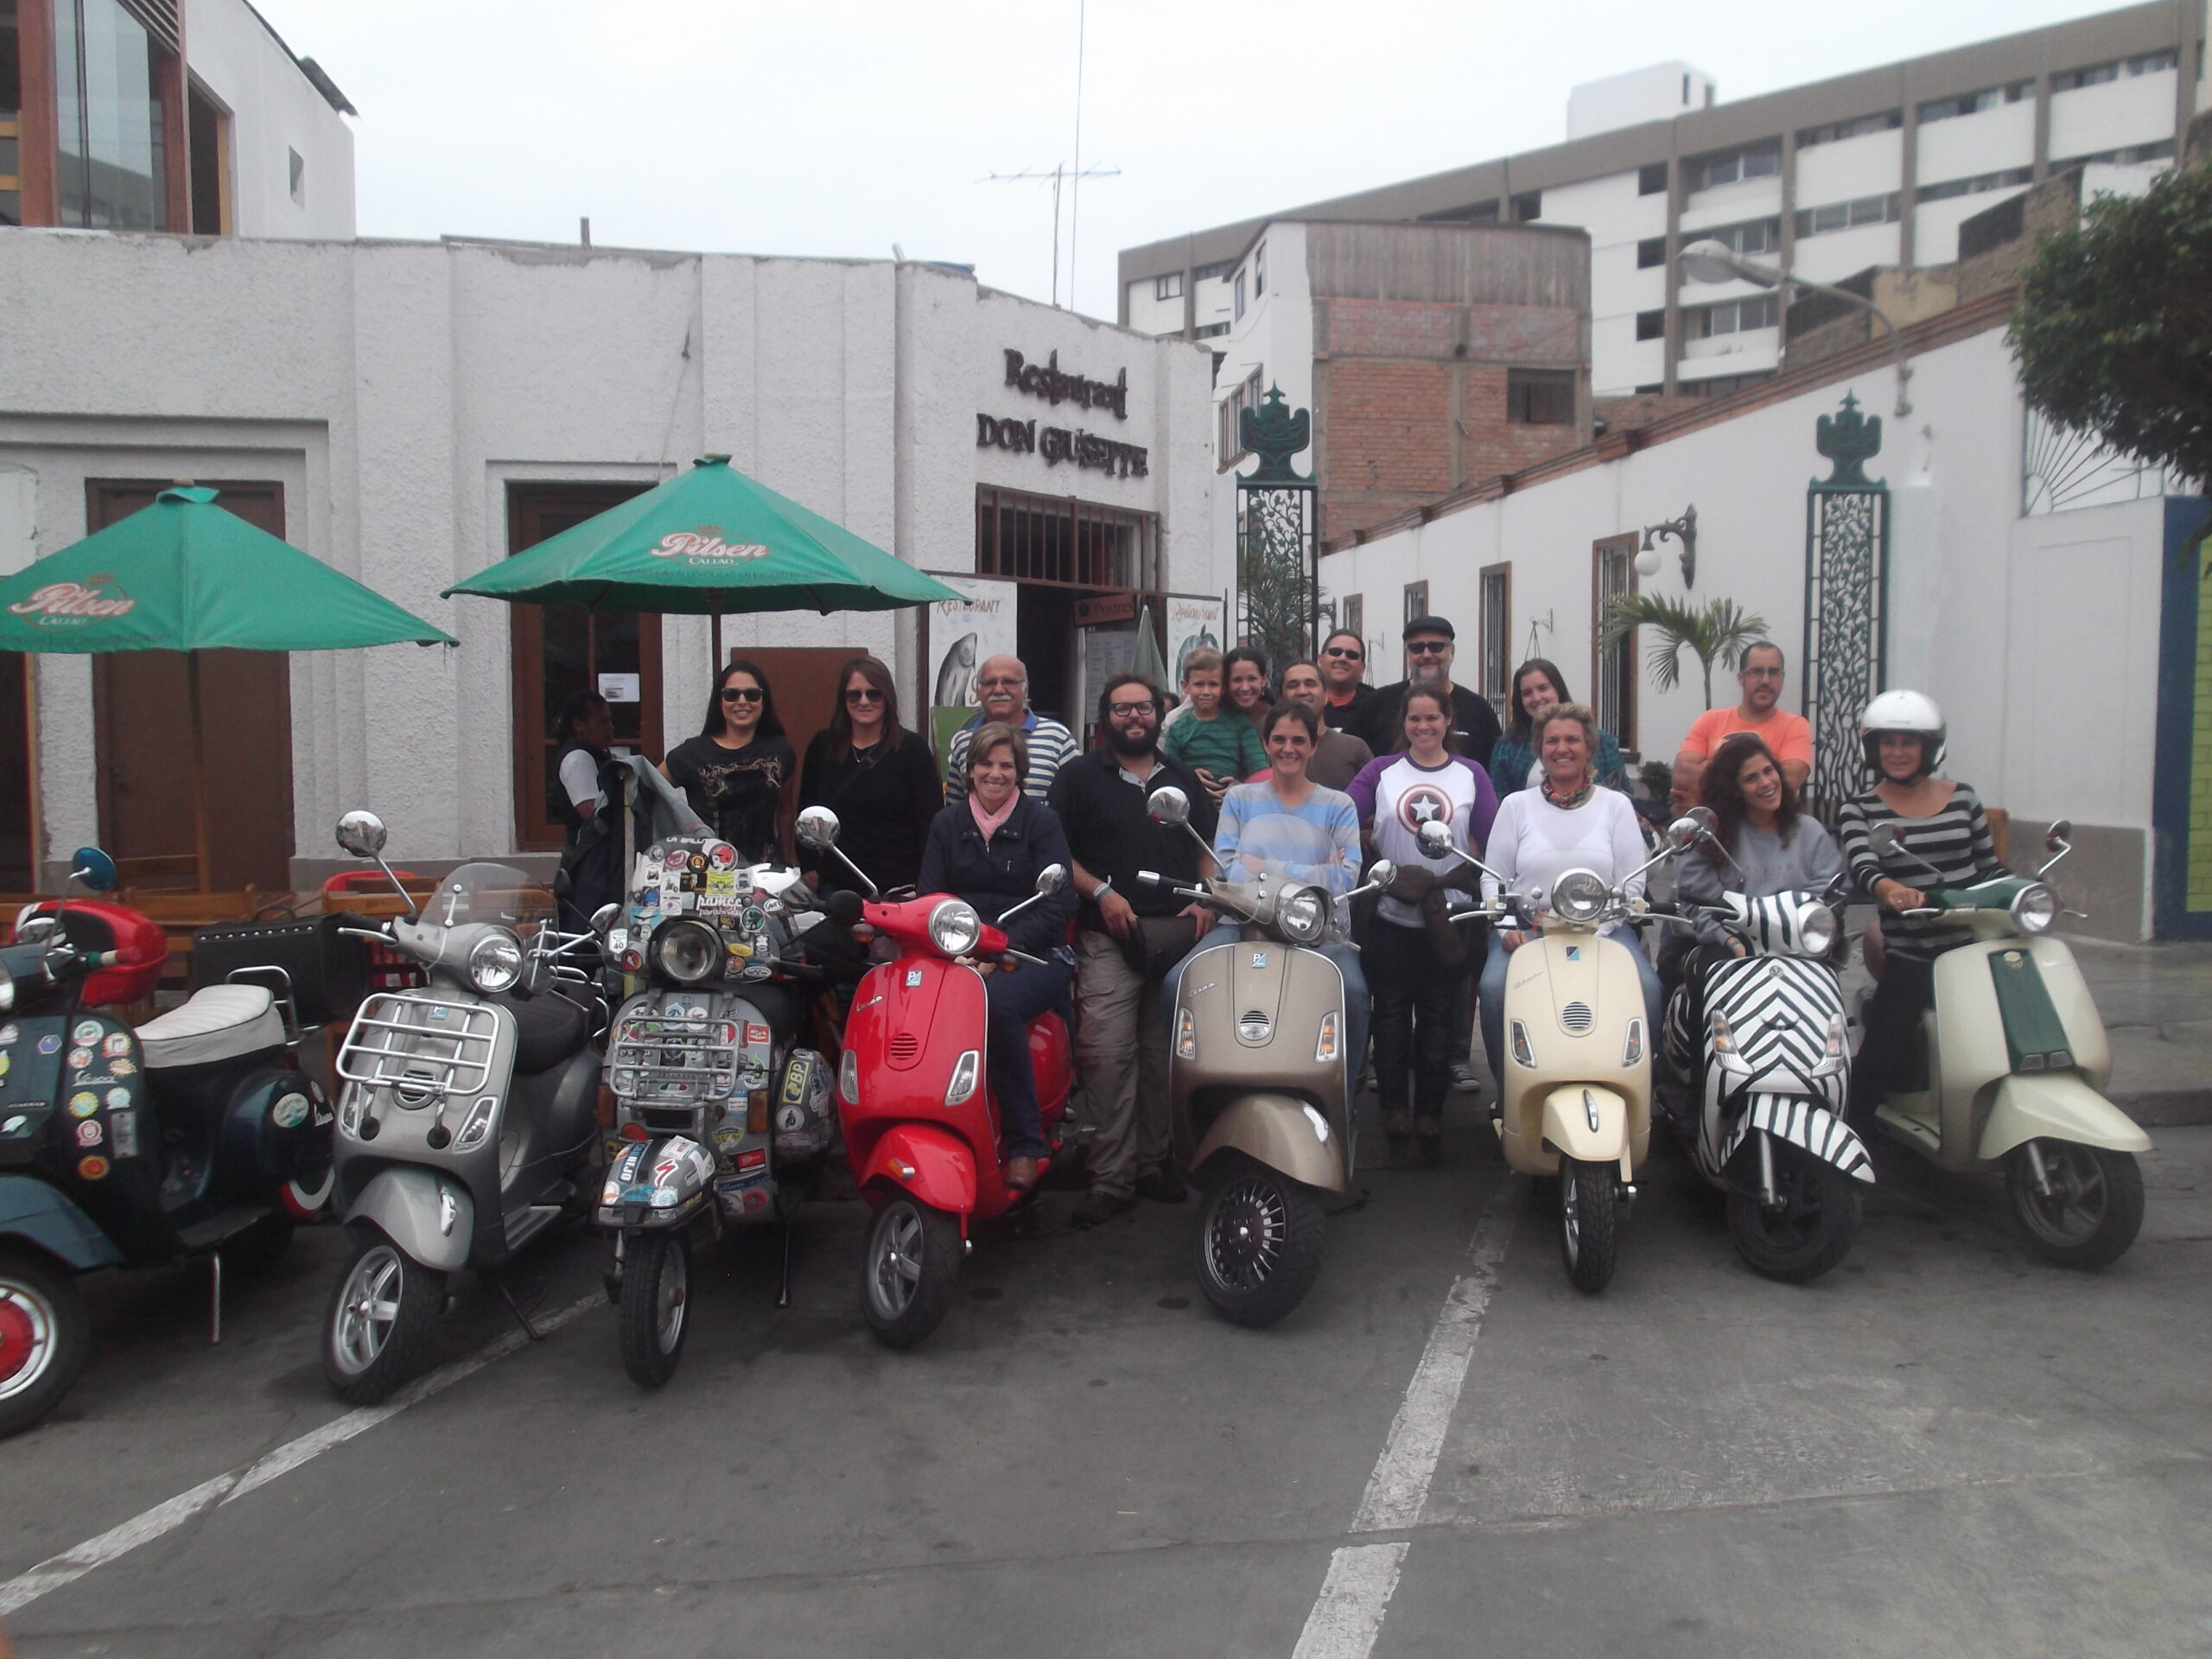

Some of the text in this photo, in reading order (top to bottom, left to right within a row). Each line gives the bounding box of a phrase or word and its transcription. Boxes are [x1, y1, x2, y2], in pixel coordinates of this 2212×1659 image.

[976, 413, 1037, 454] DON
[650, 531, 769, 557] Pilsen
[7, 582, 136, 617] Pilsen
[1095, 600, 1134, 617] Postres
